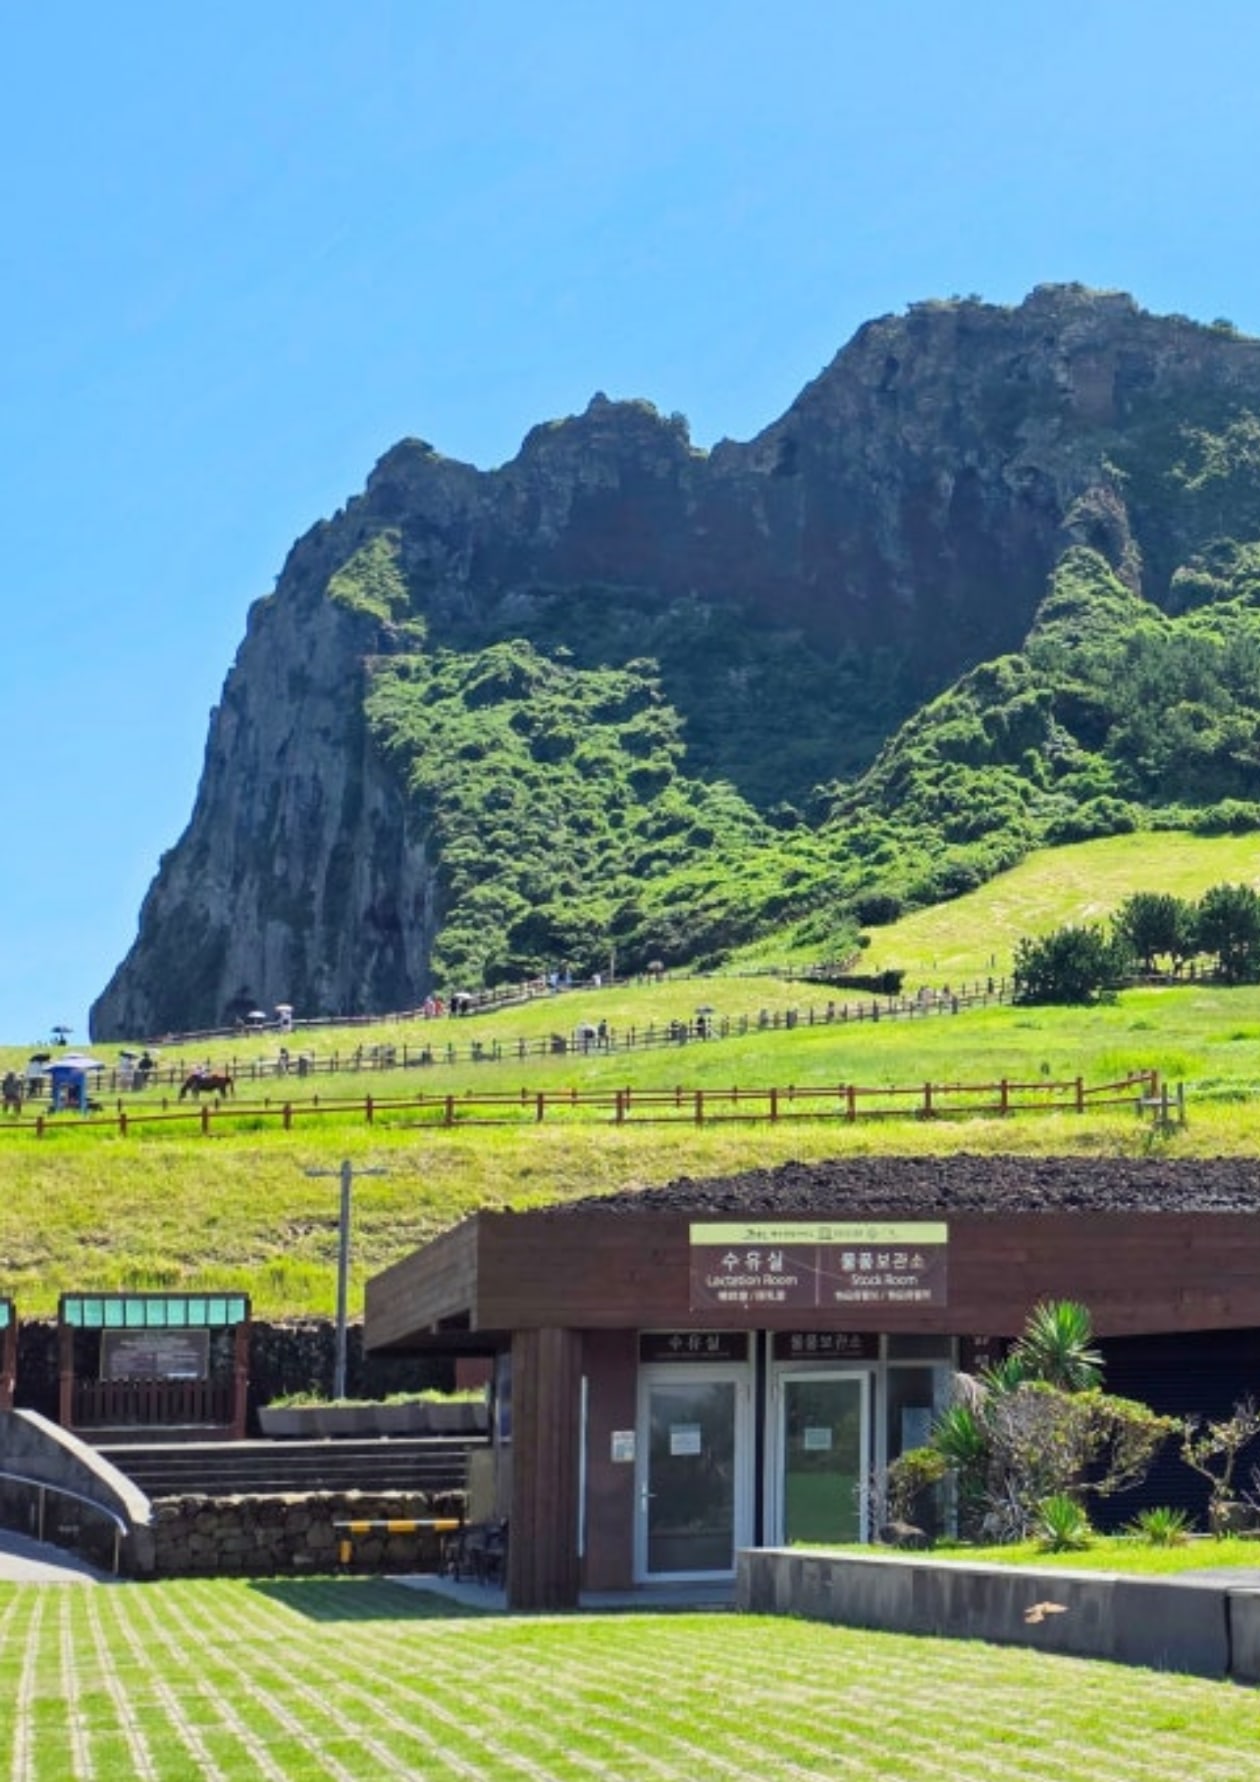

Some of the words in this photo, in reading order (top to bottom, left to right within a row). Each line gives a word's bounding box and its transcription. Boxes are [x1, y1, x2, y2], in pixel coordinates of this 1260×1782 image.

[720, 1250, 783, 1273] 수유실
[840, 1251, 926, 1272] 물품보관소
[762, 1274, 798, 1286] Room
[884, 1273, 919, 1286] Room
